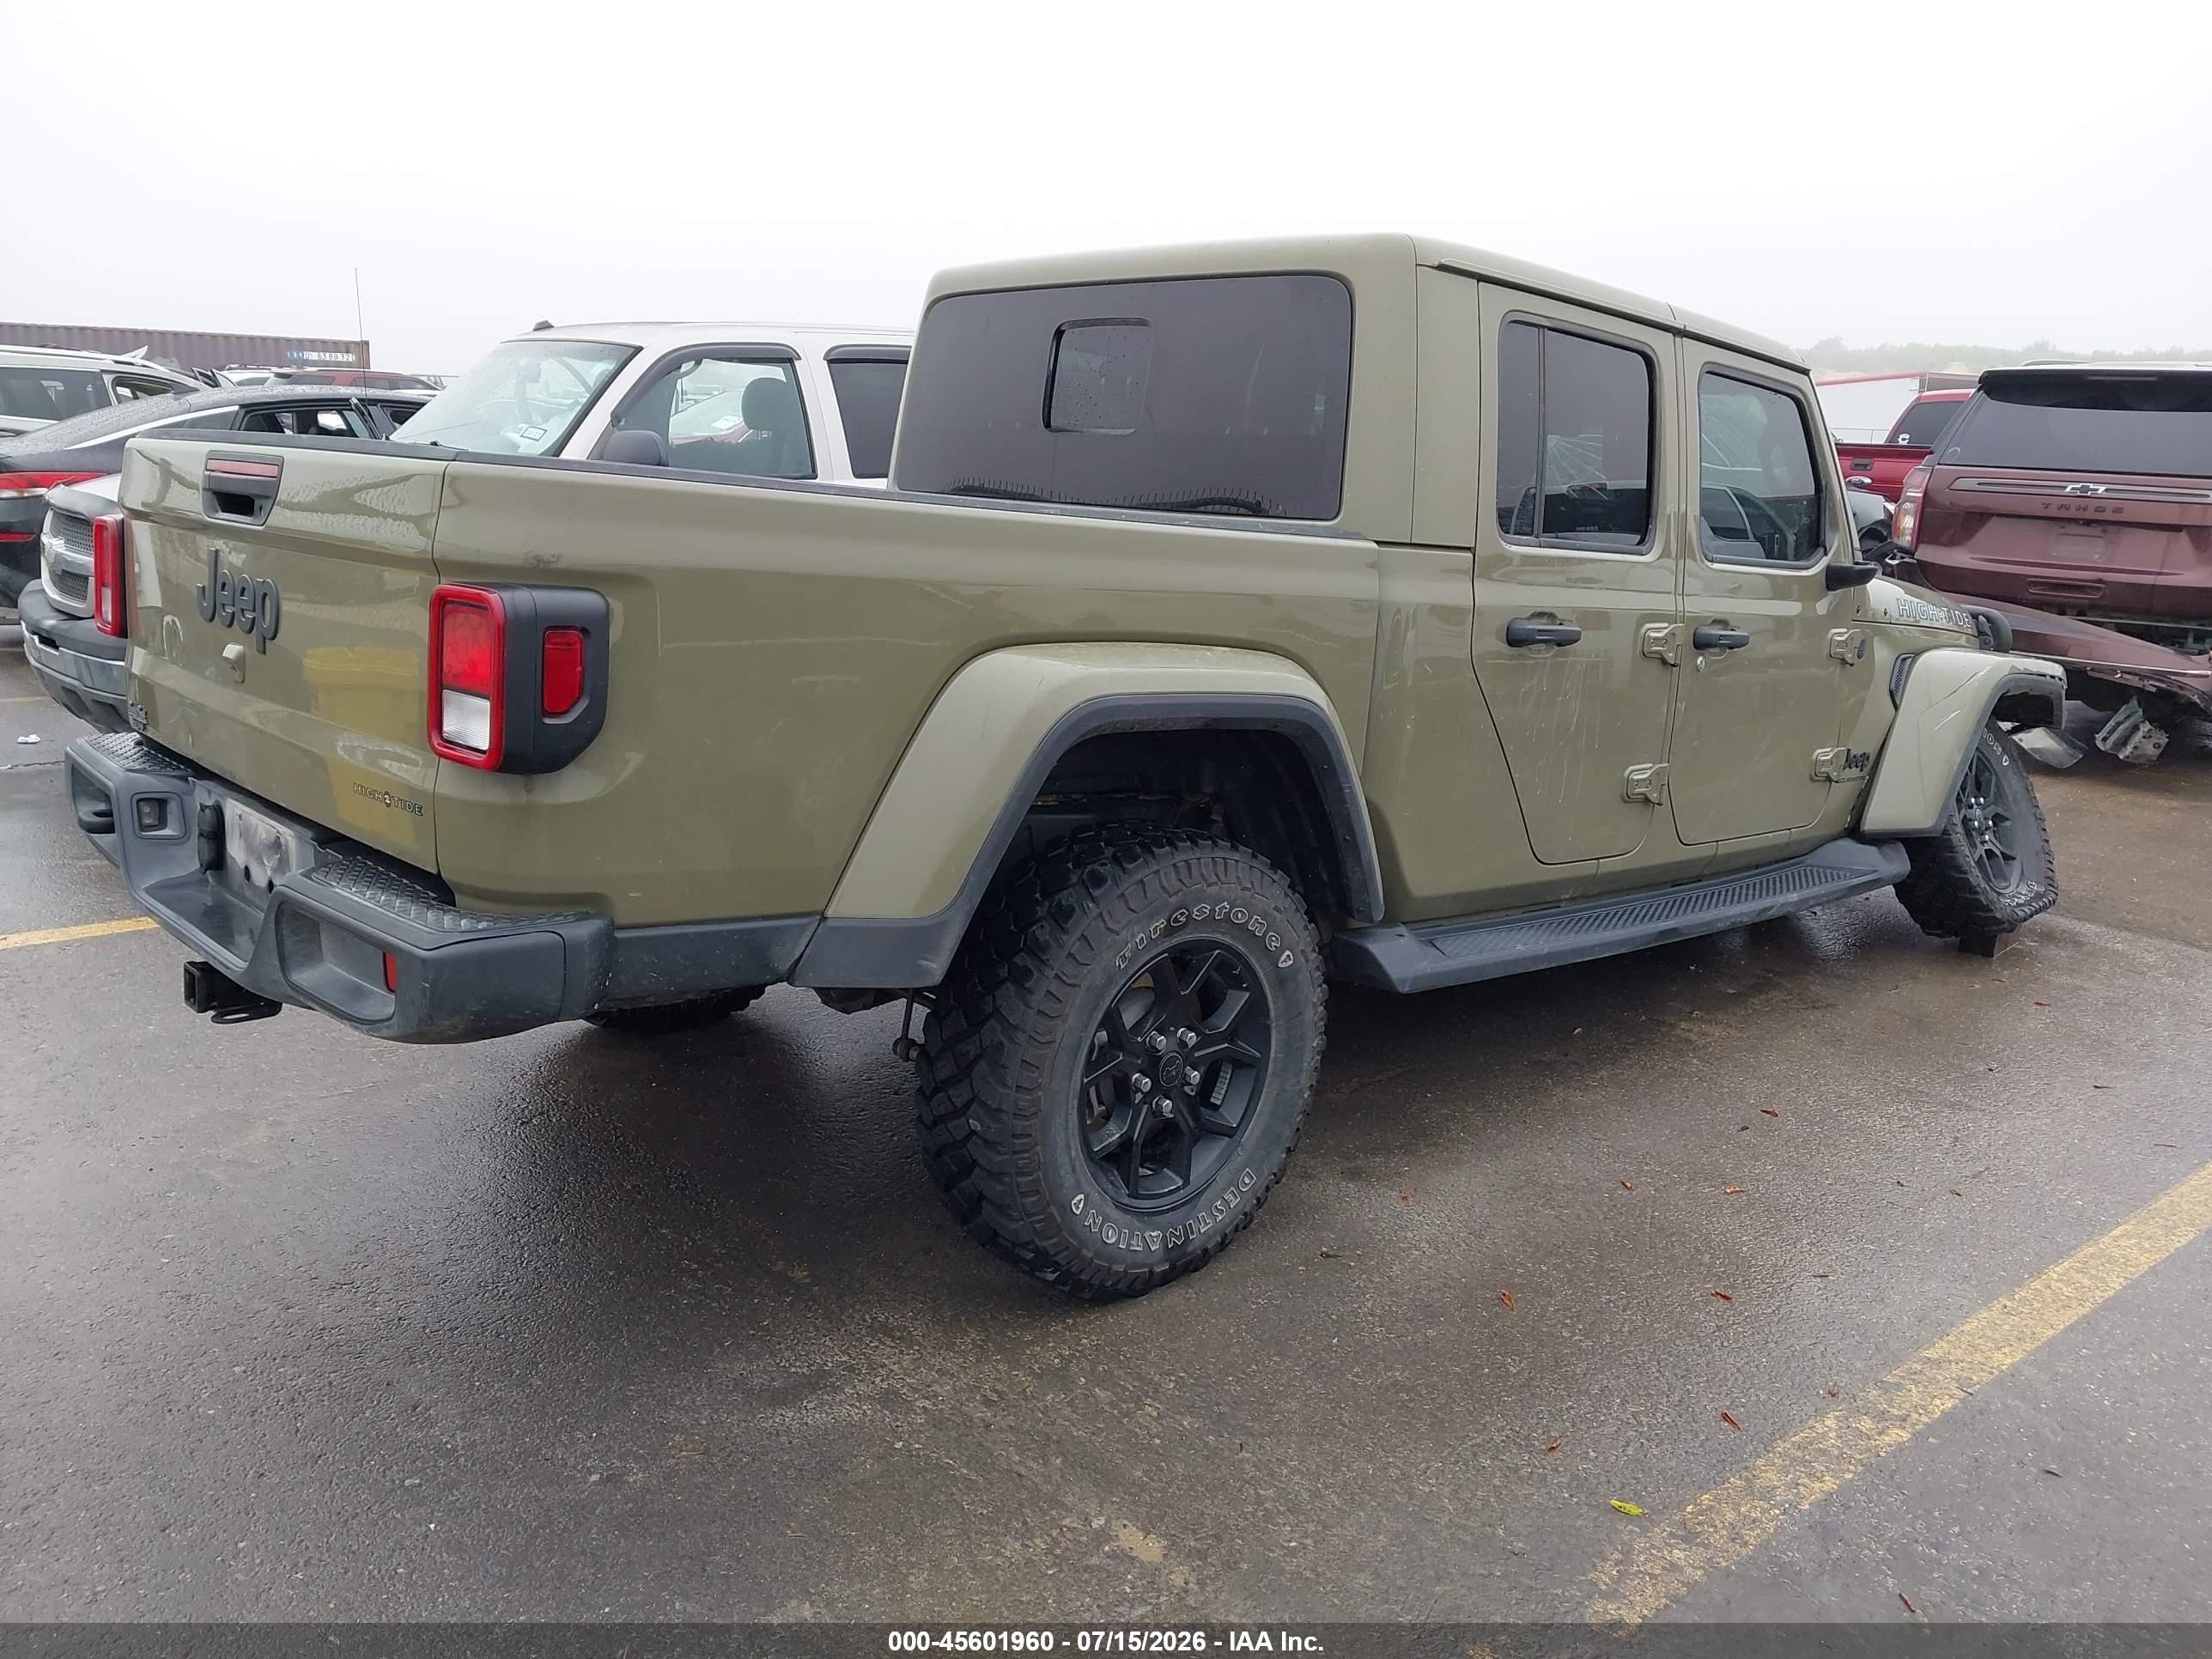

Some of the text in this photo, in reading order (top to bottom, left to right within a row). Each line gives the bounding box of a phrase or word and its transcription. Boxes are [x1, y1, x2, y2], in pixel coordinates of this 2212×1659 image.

[2041, 501, 2125, 514] TAHOE
[196, 547, 280, 655] Jeep
[1896, 598, 1972, 629] HIGH TIDE
[1842, 748, 1869, 773] Jeep
[353, 782, 423, 817] HIGH TIDE
[1116, 901, 1281, 969] Firestone
[1084, 1168, 1257, 1251] DESTINATION
